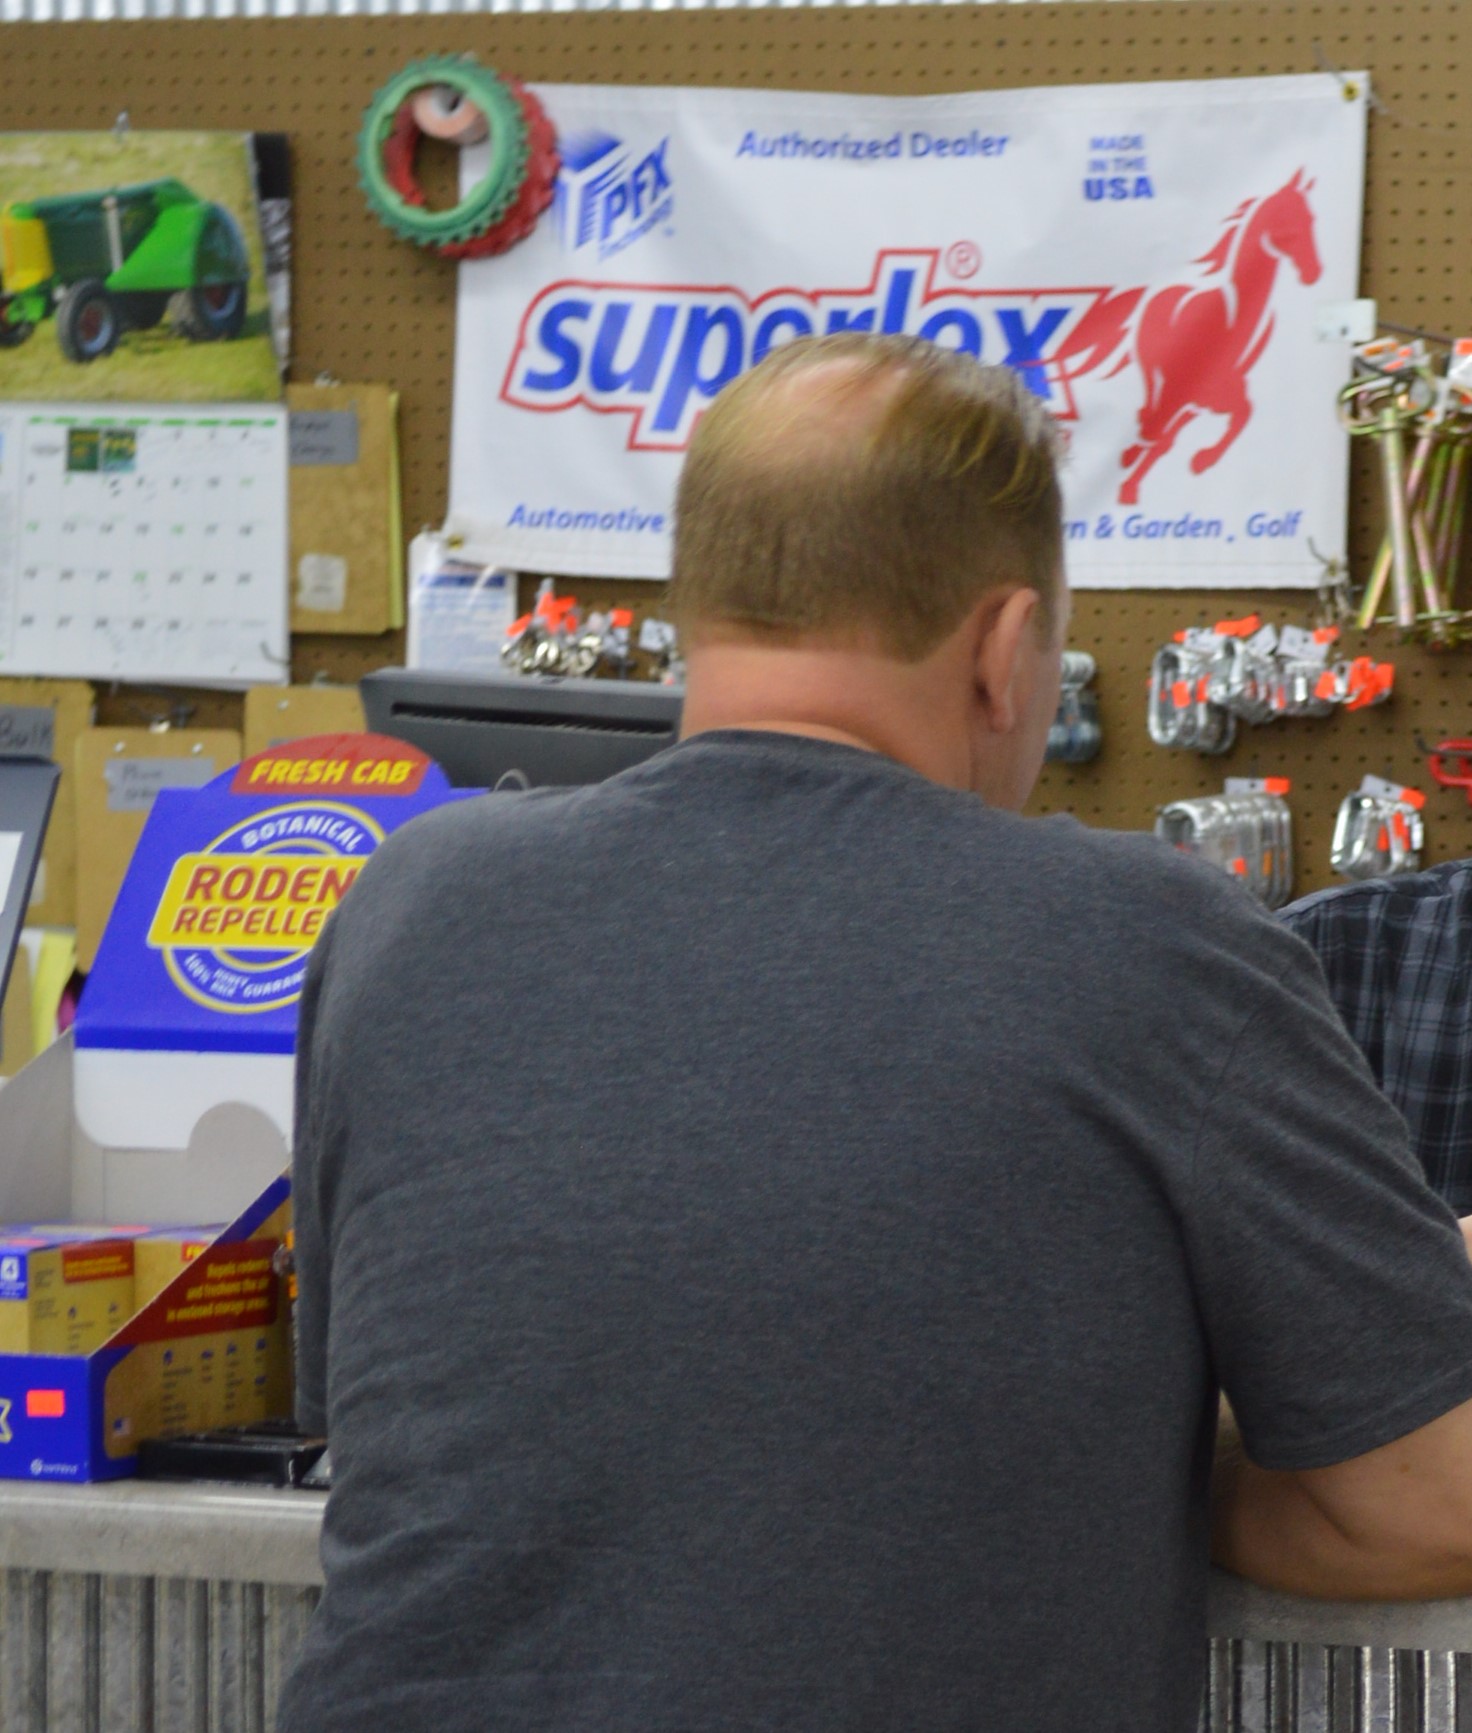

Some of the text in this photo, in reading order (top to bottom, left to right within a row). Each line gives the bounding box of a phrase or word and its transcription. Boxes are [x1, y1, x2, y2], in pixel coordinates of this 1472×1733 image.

[736, 130, 1010, 160] Authorized Dealer
[1089, 134, 1145, 151] MADE
[1088, 156, 1147, 173] IN THE
[1083, 176, 1155, 201] USA
[521, 268, 1074, 432] supelex
[507, 503, 666, 533] Automotive
[1095, 514, 1114, 539] &
[1246, 510, 1303, 538] Golf
[248, 758, 415, 785] FRESH CAB
[241, 814, 365, 851] BOTANICAL
[172, 907, 334, 936] REPELLE
